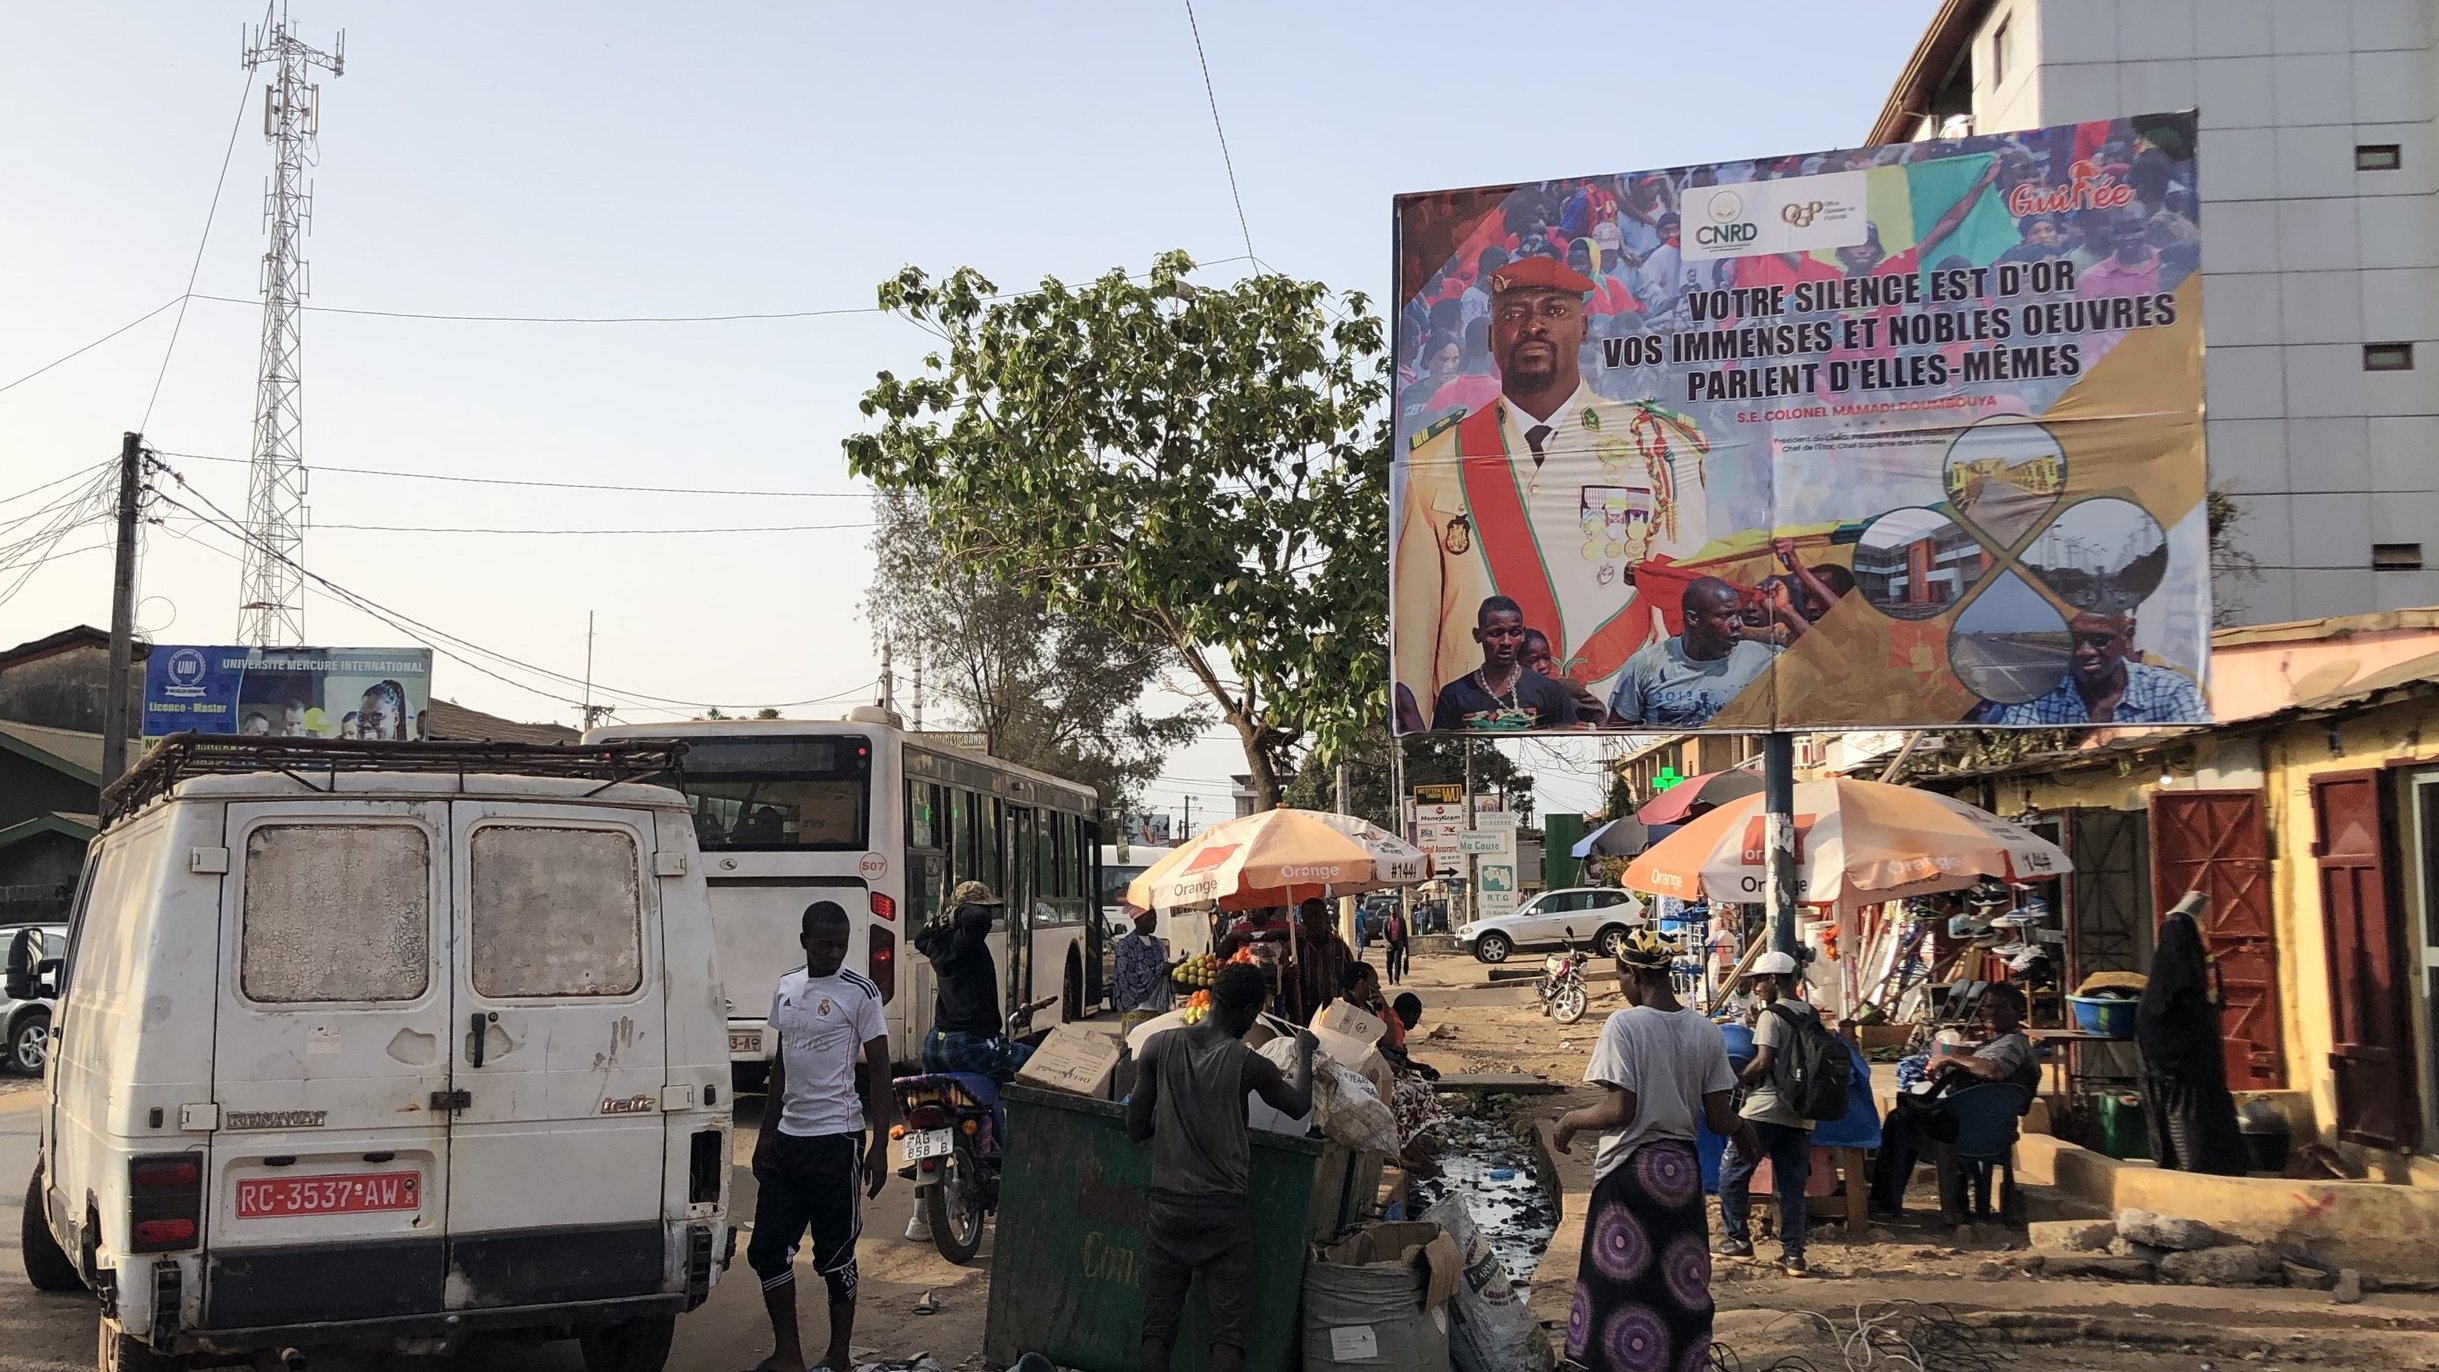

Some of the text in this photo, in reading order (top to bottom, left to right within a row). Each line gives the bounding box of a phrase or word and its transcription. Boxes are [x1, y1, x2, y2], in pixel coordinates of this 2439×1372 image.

[1695, 223, 1758, 245] CNRD
[1688, 260, 2076, 322] VOTRE SILENCE EST D'OR
[1602, 293, 2178, 369] VOS IMMENSES ET NOBLES OEUVRES
[1687, 342, 2081, 402] PARLENT D'ELLES-MÊMES
[1737, 412, 1761, 423] S.E.
[1764, 406, 1829, 421] COLONEL
[1832, 402, 1895, 416] MAMADI
[177, 660, 197, 674] UMI
[223, 658, 425, 673] UNIVERSITE MERCURE INTERNATIONAL
[193, 702, 228, 713] Master
[1442, 787, 1459, 803] WU
[1460, 841, 1500, 850] Ma Cause
[862, 859, 885, 872] S07
[1281, 865, 1340, 879] Orange
[1174, 878, 1218, 897] Orange
[1651, 868, 1683, 890] Orange
[226, 1110, 328, 1130] RENAULT
[907, 1142, 948, 1159] 858 B
